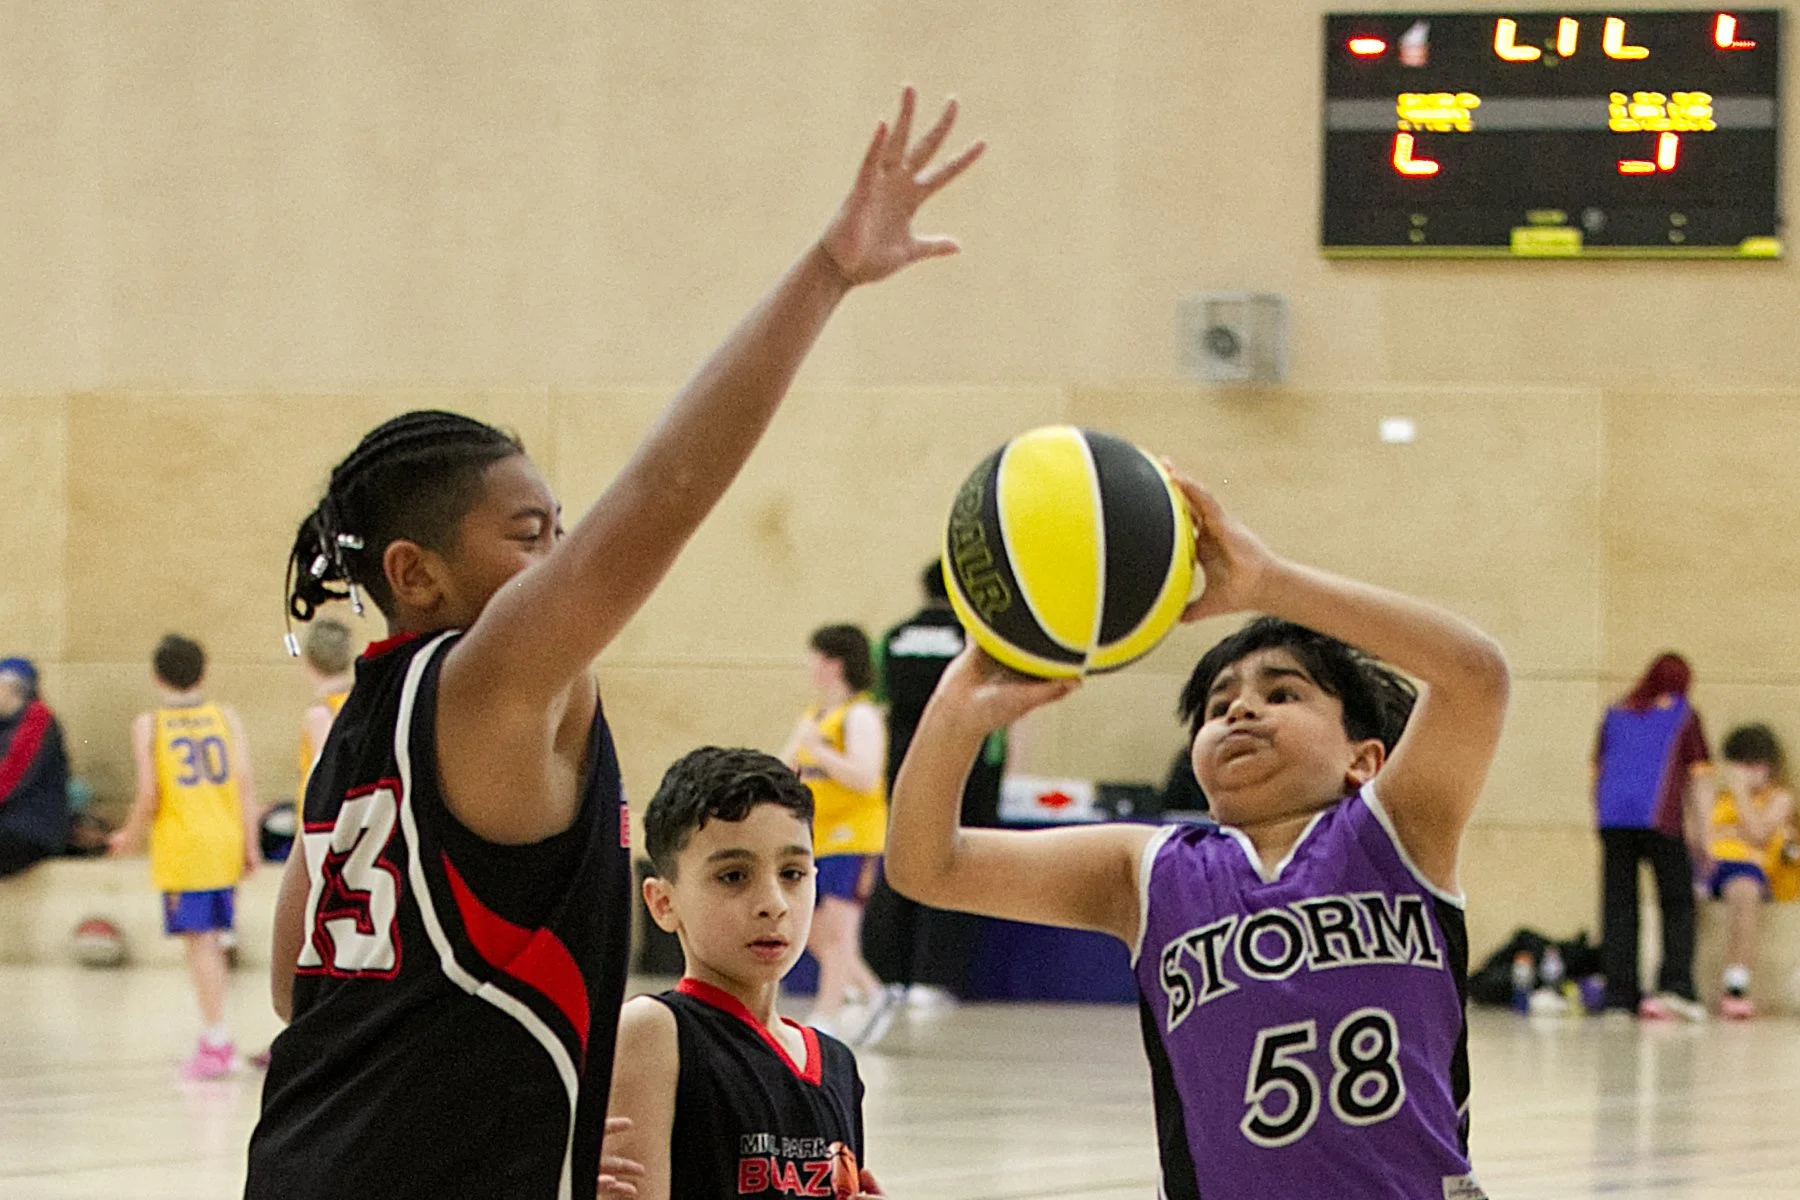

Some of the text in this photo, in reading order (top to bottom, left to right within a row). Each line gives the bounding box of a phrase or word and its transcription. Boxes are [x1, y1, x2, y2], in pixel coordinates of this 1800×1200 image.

[170, 736, 229, 785] 30
[1159, 892, 1444, 1033] STORM
[1240, 1007, 1406, 1148] 58
